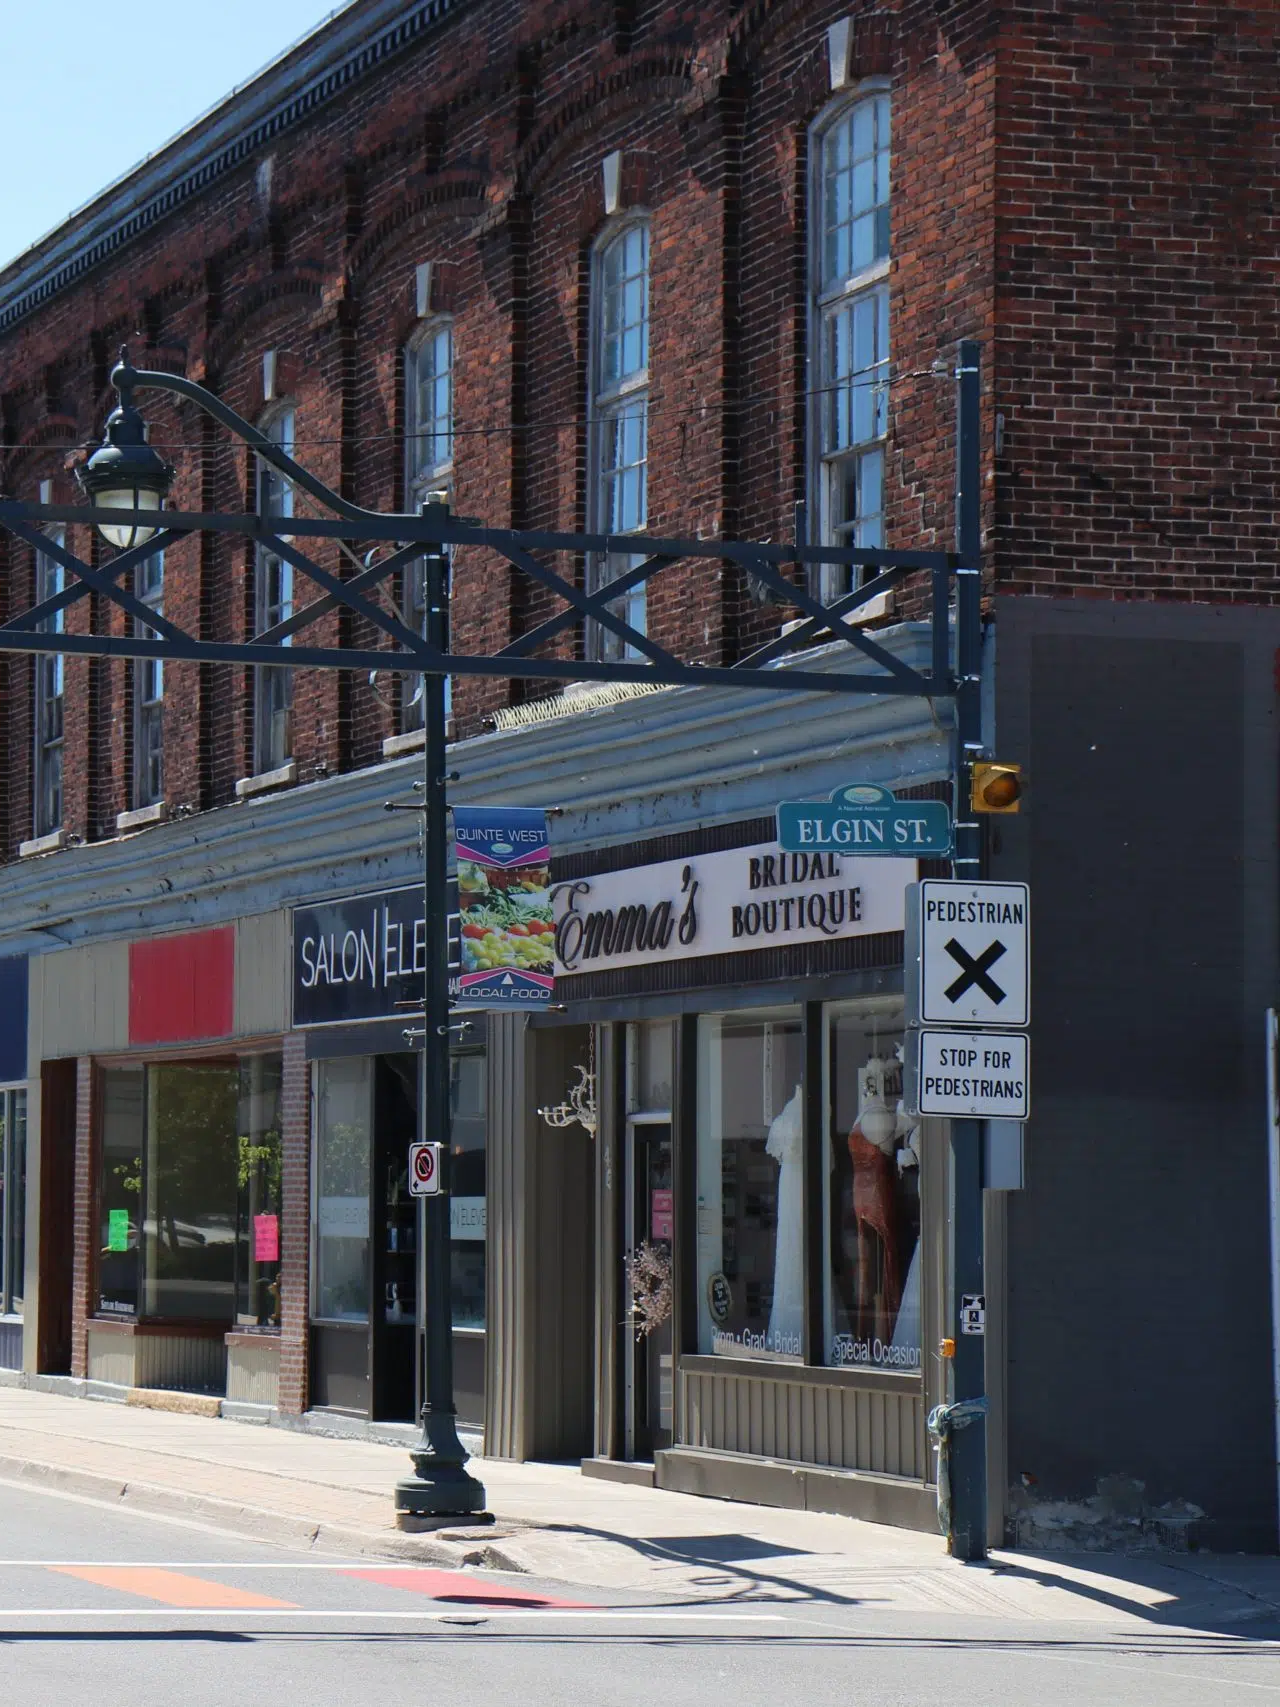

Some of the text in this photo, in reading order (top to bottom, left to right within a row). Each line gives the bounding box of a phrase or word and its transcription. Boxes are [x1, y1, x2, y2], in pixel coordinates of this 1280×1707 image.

[456, 828, 546, 842] QUINTE WEST
[798, 819, 932, 843] ELGIN ST.
[749, 852, 840, 890] BRIDAL
[550, 865, 698, 970] Emma's
[731, 887, 862, 938] BOUTIQUE
[927, 900, 1023, 924] PEDESTRIAN
[301, 909, 377, 988] SALON
[462, 988, 551, 999] LOCAL FOOD
[940, 1048, 1011, 1069] STOP FOR
[925, 1077, 1023, 1099] PEDESTRIANS
[711, 1326, 802, 1355] Prom Grad Bridal
[833, 1336, 871, 1365] Special
